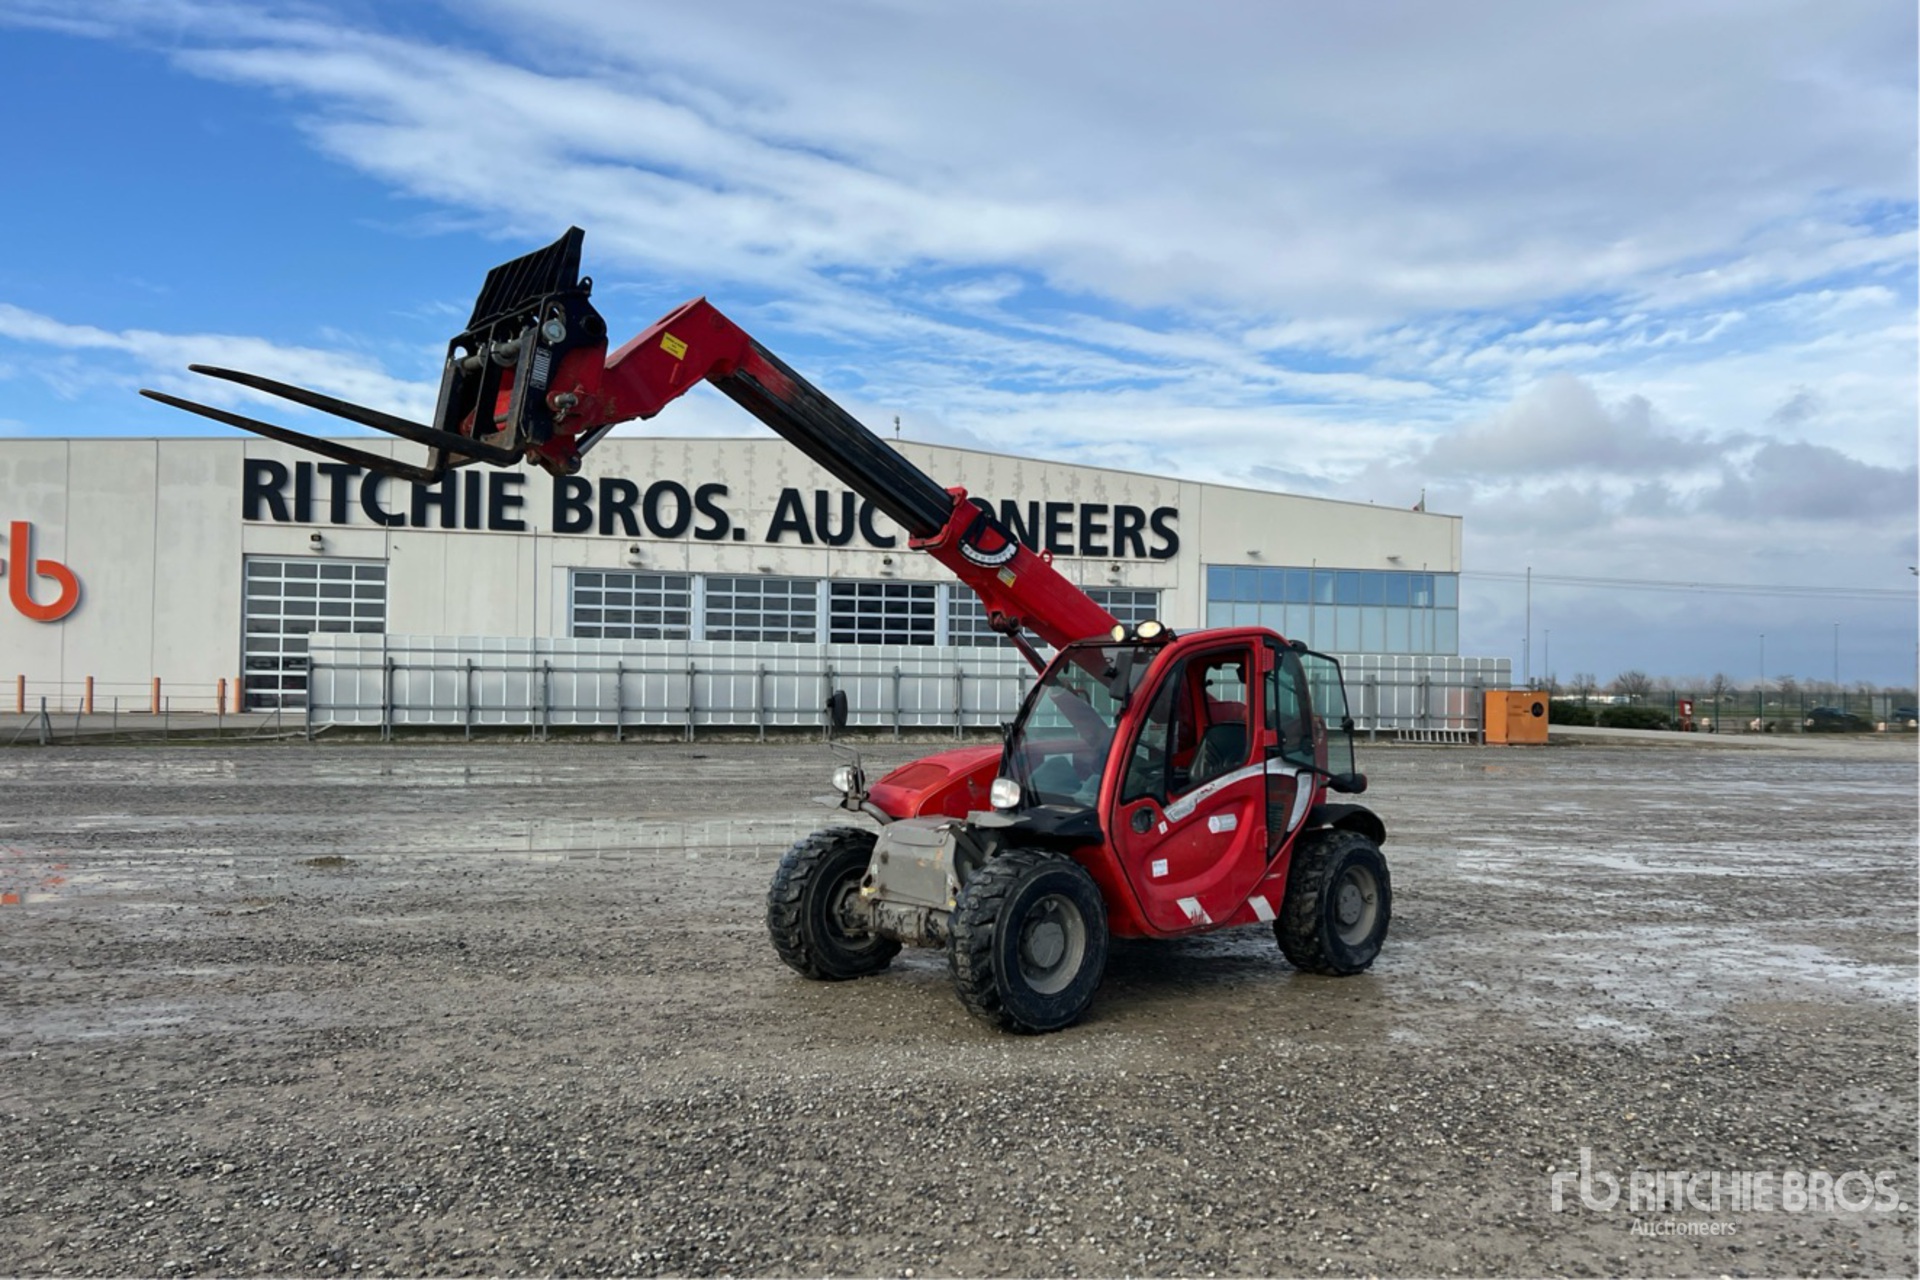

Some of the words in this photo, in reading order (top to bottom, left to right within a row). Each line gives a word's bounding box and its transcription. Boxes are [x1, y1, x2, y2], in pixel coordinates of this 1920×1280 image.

[243, 458, 526, 531] RITCHIE
[553, 475, 746, 541] BROS.
[765, 487, 1180, 559] AUCNEERS
[0, 521, 80, 622] b
